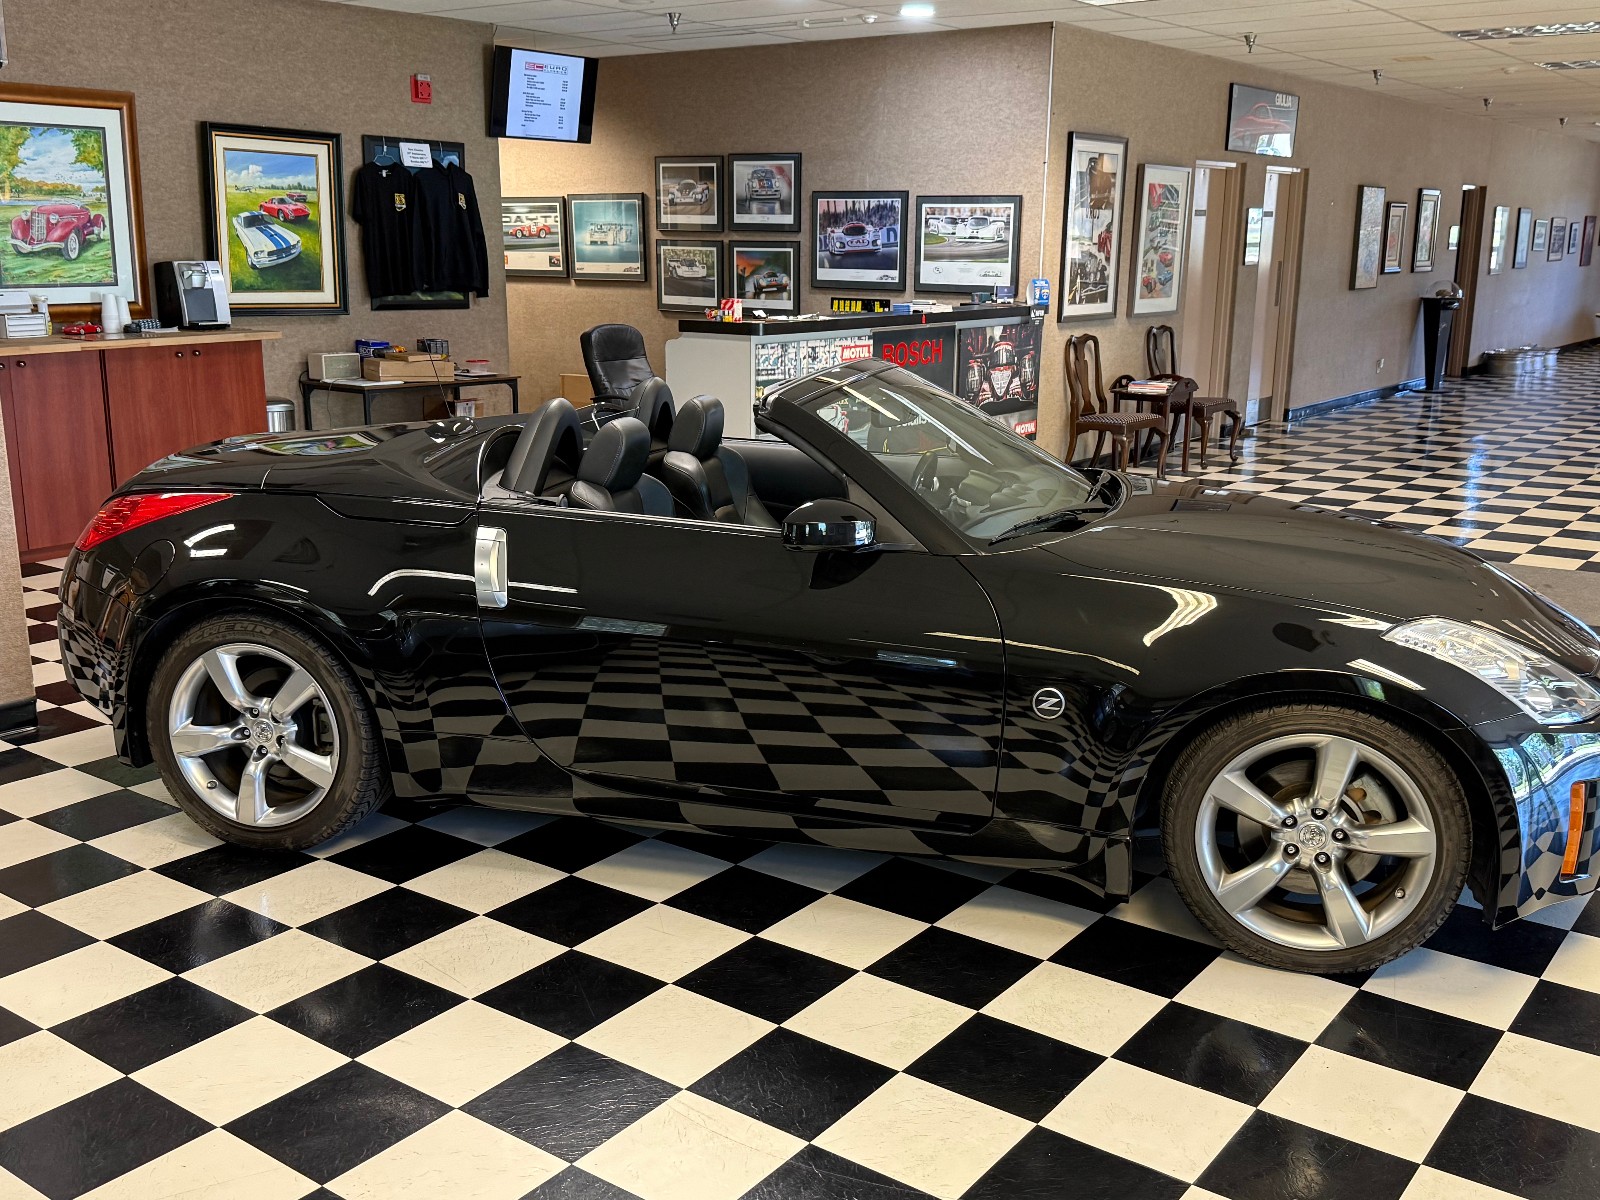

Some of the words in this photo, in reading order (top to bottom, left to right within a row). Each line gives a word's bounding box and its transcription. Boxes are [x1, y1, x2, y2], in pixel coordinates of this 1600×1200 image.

[1275, 93, 1292, 107] GIULIA
[843, 346, 869, 359] MOTUL
[882, 338, 943, 368] BOSCH
[1015, 422, 1036, 434] MOTUL
